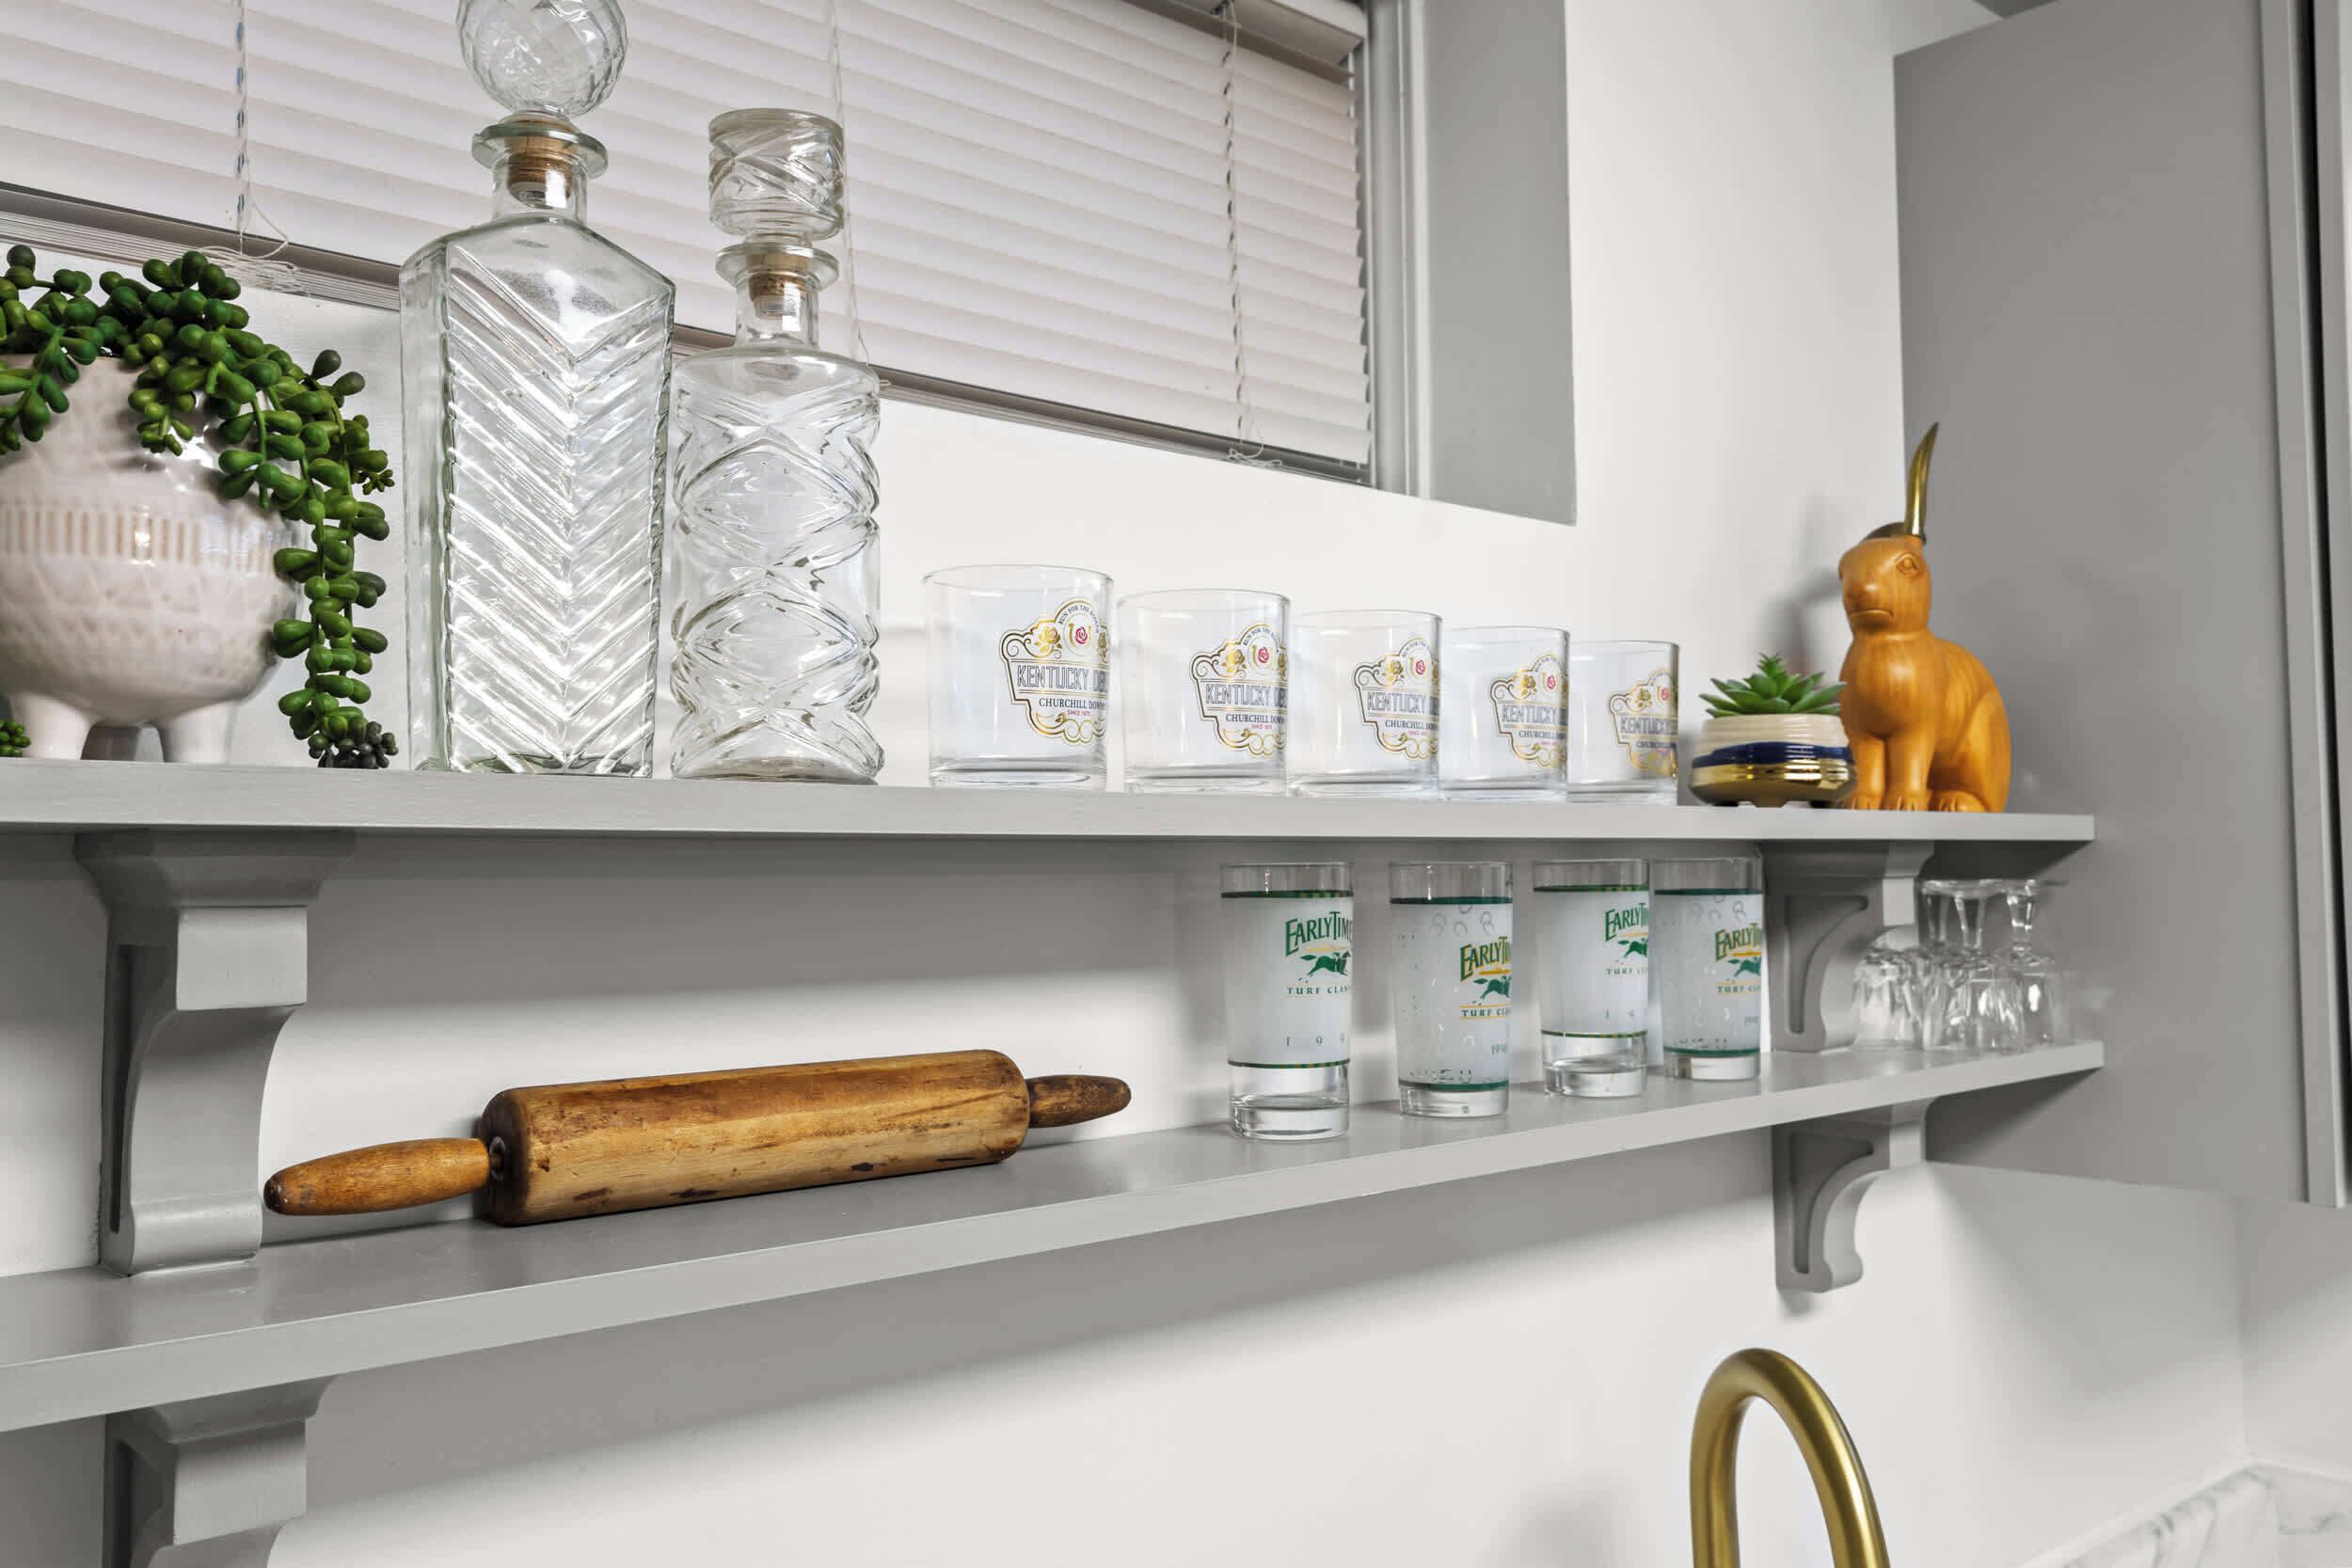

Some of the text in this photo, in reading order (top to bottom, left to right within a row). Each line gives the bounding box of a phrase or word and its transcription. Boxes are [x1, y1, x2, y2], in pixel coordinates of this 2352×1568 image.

[1017, 665, 1089, 690] KENTUCKY
[1039, 698, 1087, 708] CHURCHILL
[1205, 683, 1271, 706] KENTUCKY
[1367, 691, 1426, 713] KENTUCKY
[1226, 714, 1268, 723] CHURCHILL
[1502, 705, 1557, 723] KENTUCKY
[1385, 720, 1423, 730] CHURCHILL
